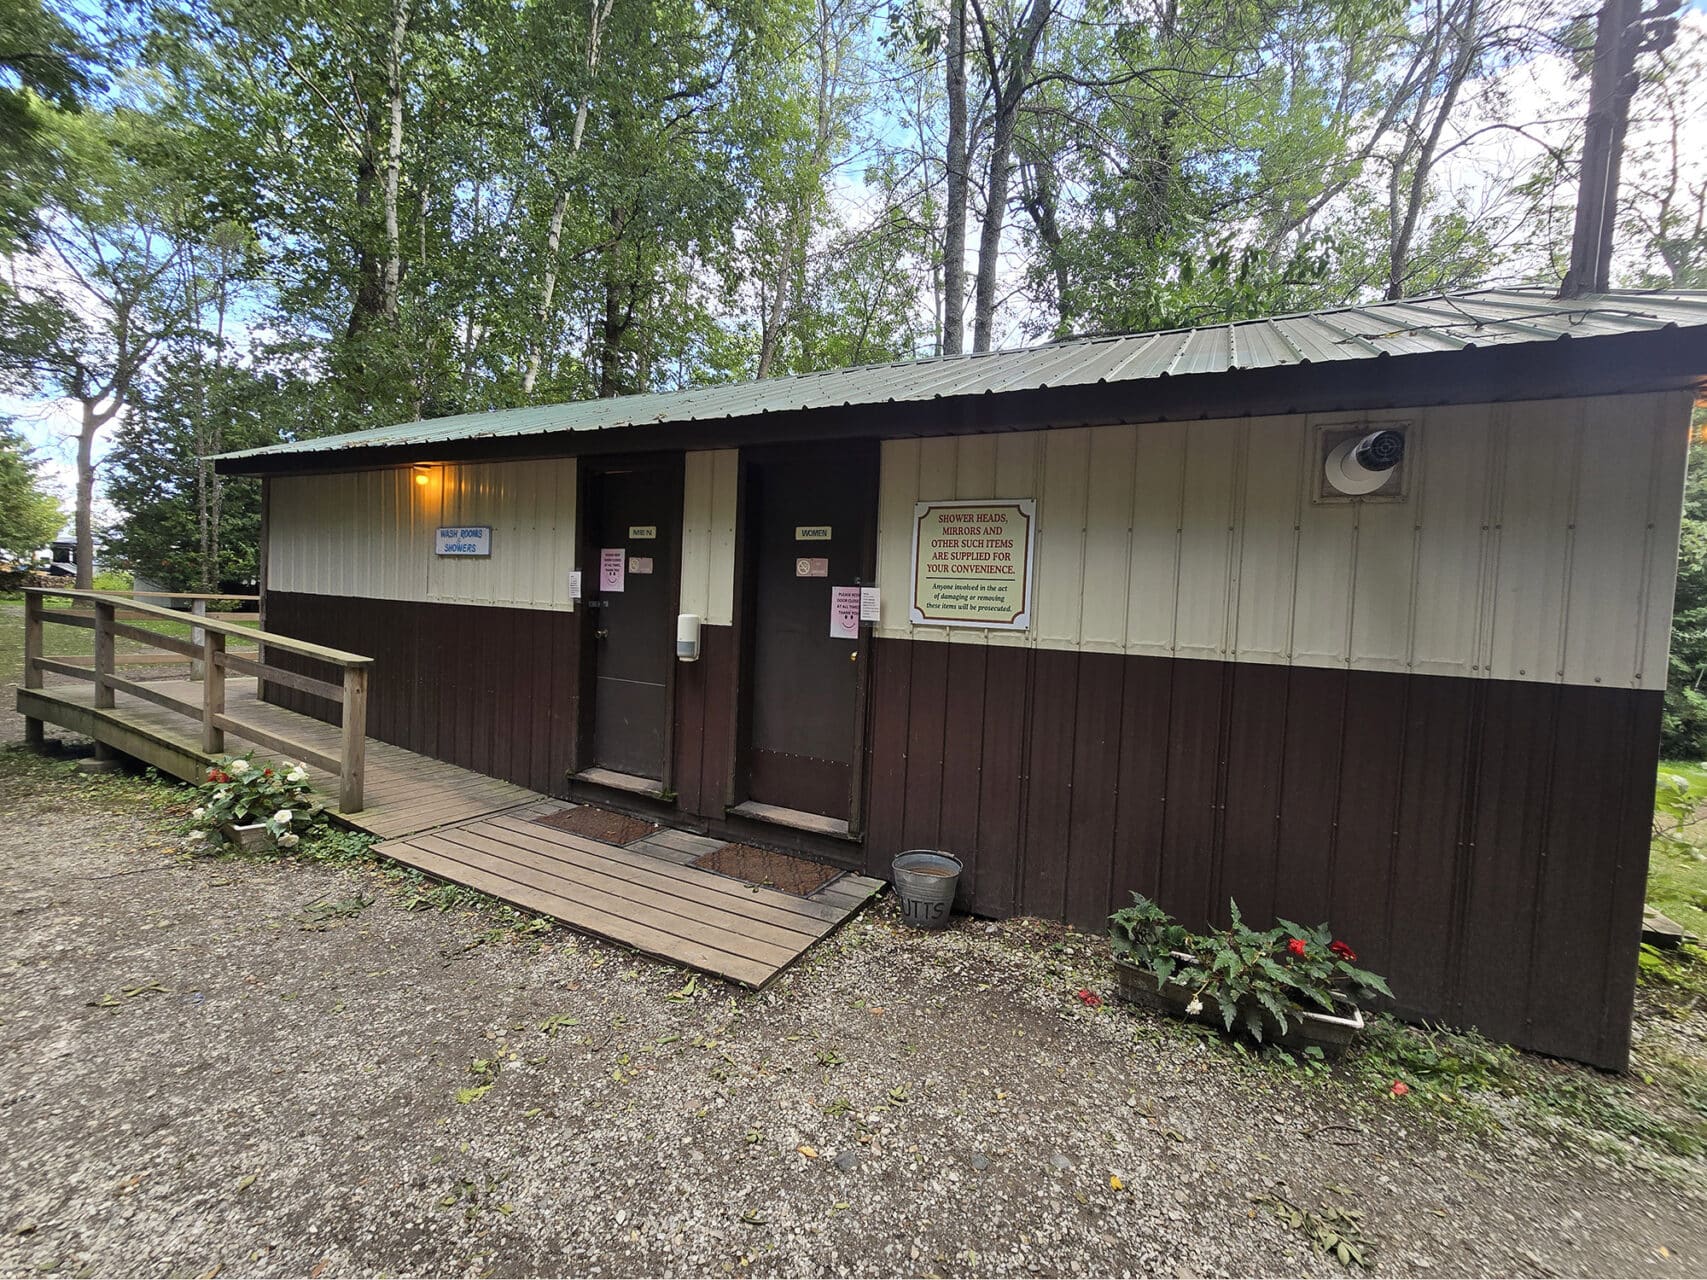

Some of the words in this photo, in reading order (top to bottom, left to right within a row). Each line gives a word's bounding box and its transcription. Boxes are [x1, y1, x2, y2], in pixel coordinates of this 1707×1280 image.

[938, 514, 976, 523] SHOWER
[976, 513, 1009, 524] HEADS,
[461, 530, 482, 538] ROOMS
[801, 529, 827, 537] WOMEN
[942, 526, 981, 536] MIRRORS
[983, 526, 1003, 536] AND
[444, 544, 476, 552] SHOWERS
[931, 539, 959, 548] OTHER
[961, 539, 984, 548] SUCH
[985, 539, 1014, 549] ITEMS
[931, 551, 949, 561] ARE
[950, 551, 991, 561] SUPPLIED
[993, 552, 1011, 561] FOR
[927, 563, 949, 573] YOUR
[951, 564, 1015, 575] CONVENIENCE.
[932, 583, 953, 591] Anyone
[954, 583, 979, 591] involved
[940, 593, 968, 601] damaging
[977, 595, 1005, 603] removing
[977, 604, 1012, 612] prosecuted.
[901, 894, 945, 920] UTTS
